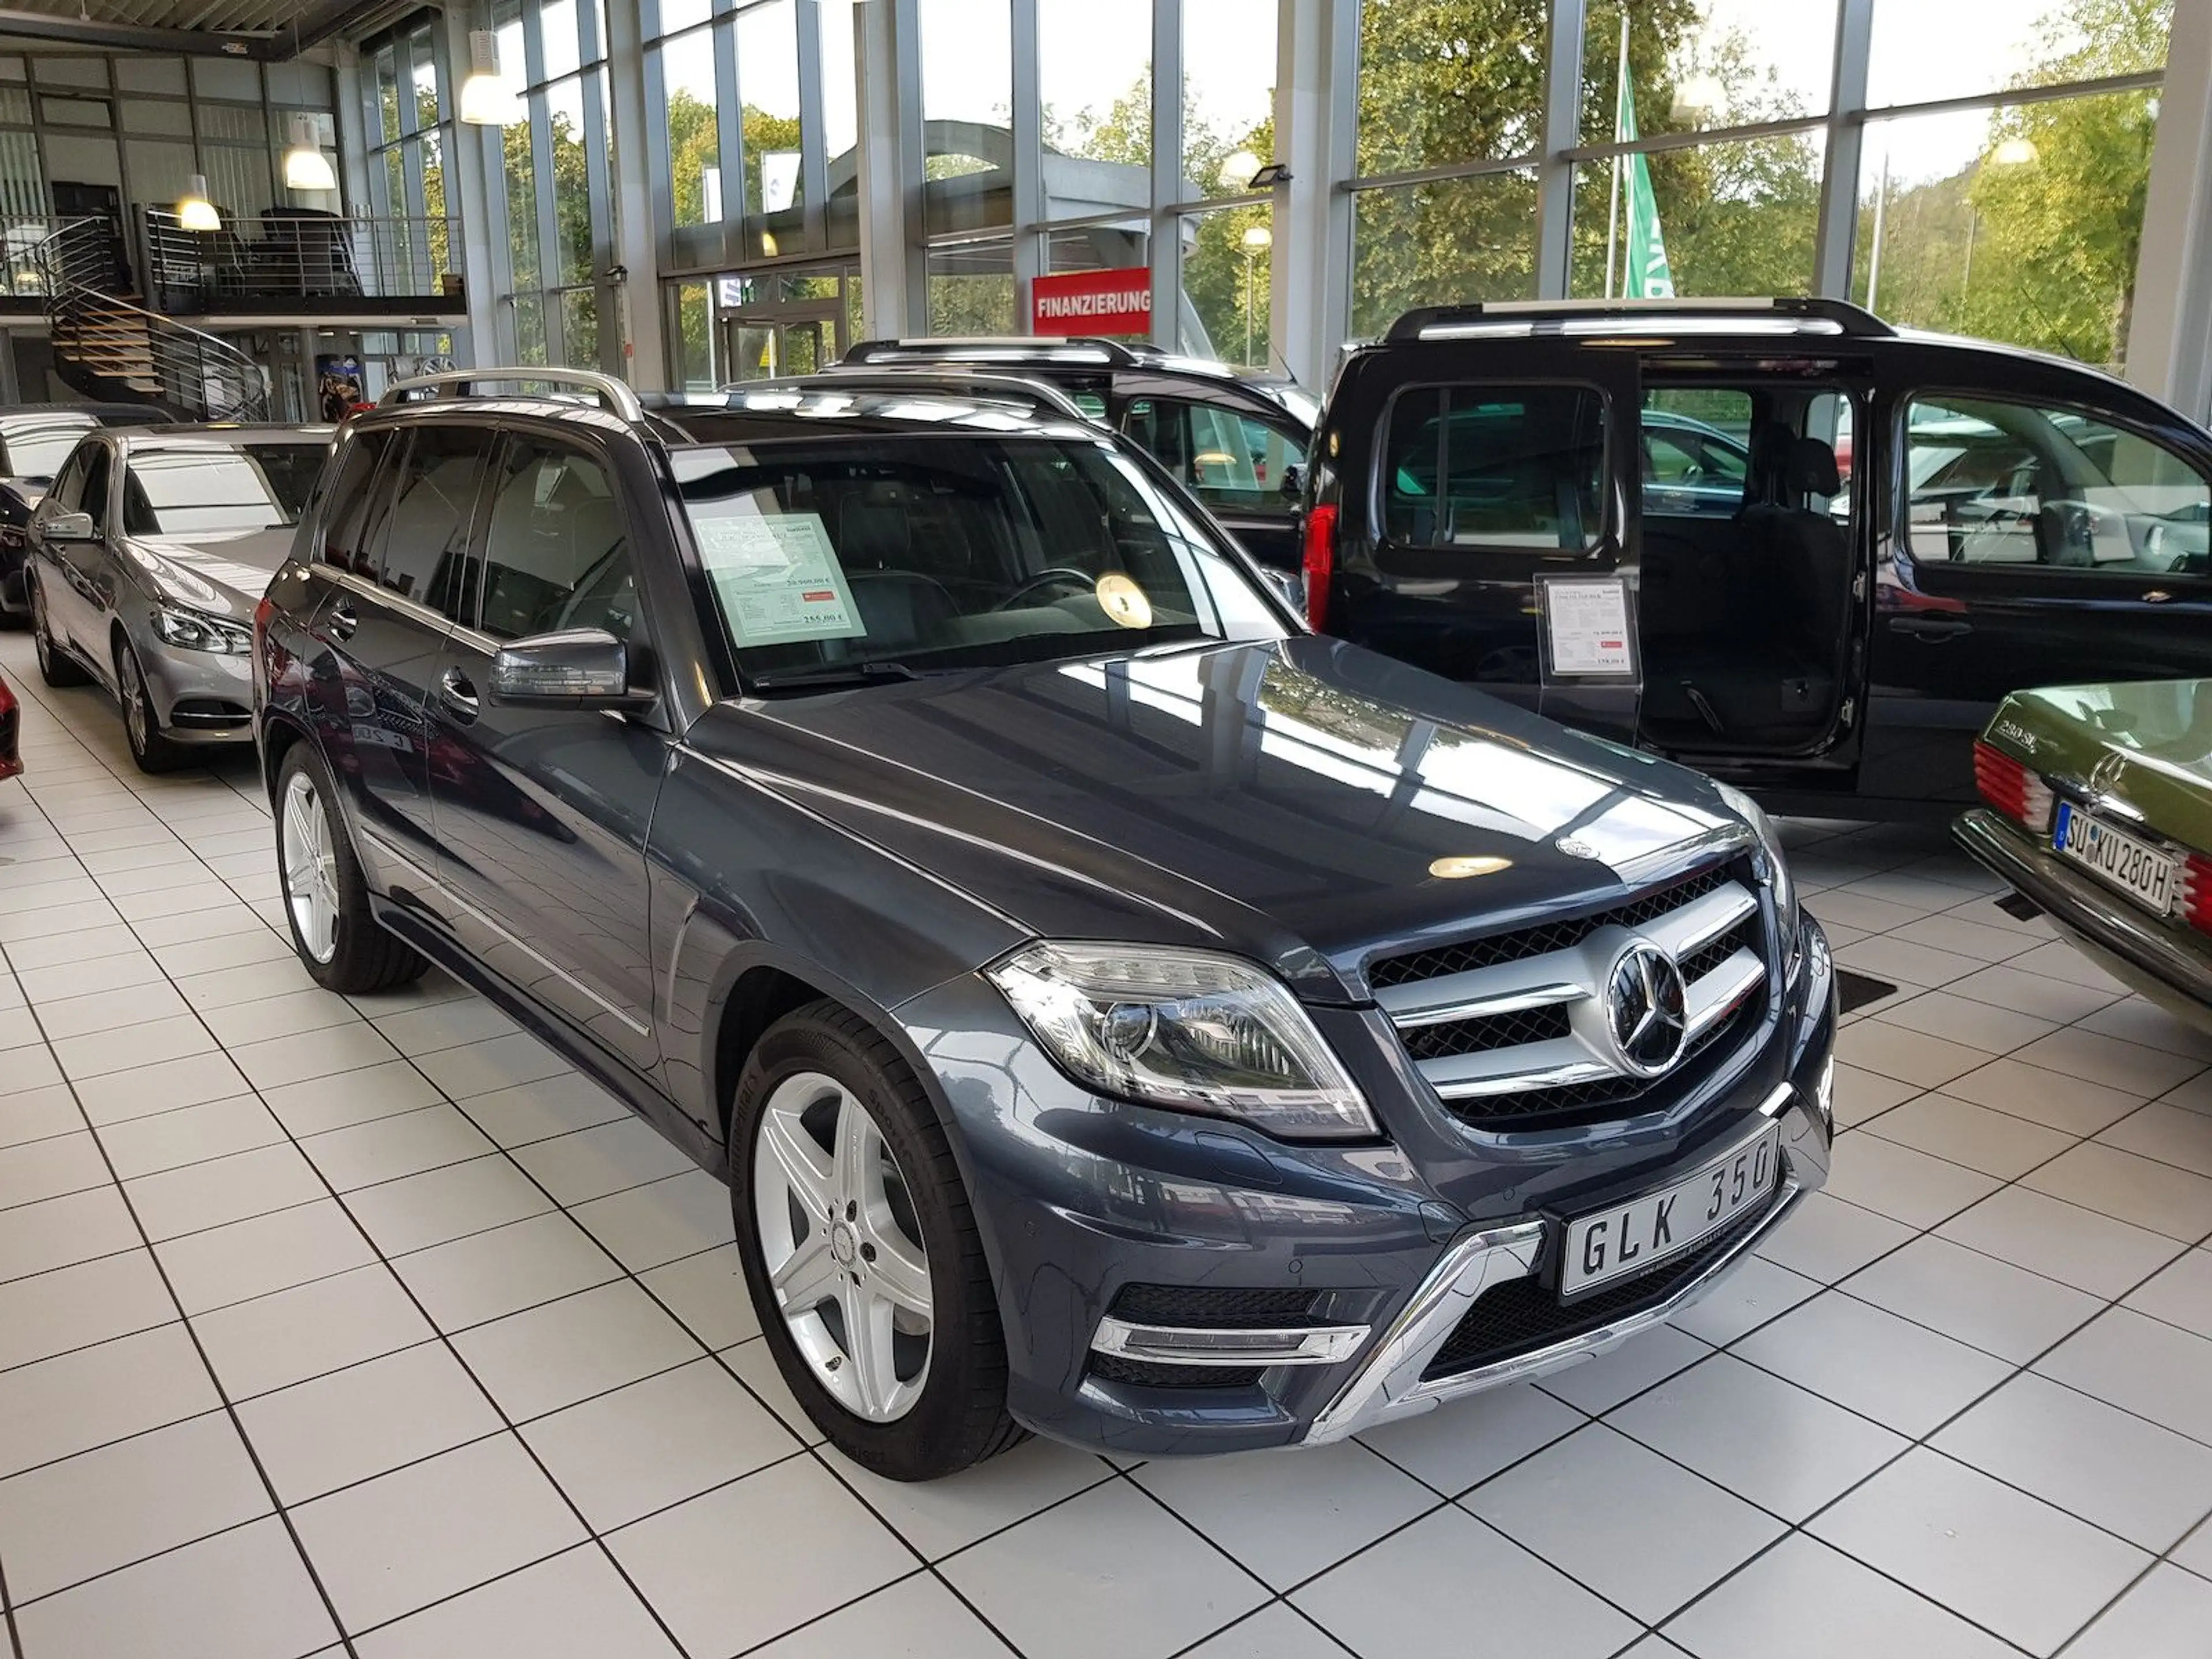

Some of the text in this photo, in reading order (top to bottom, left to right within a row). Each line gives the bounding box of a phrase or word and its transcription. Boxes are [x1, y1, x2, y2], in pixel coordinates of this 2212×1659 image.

[1038, 290, 1151, 318] FINANZIERUNG
[2066, 815, 2089, 855] SU
[2118, 843, 2168, 901] 280H
[1707, 1141, 1768, 1221] 350
